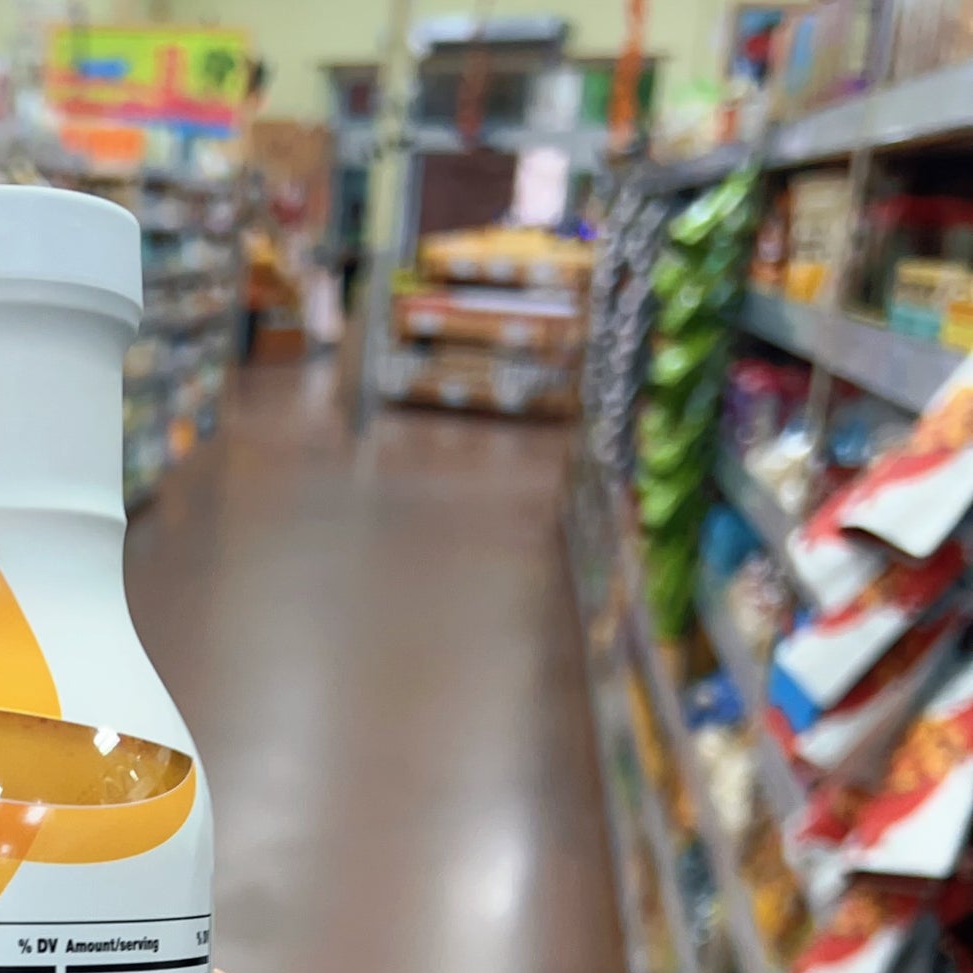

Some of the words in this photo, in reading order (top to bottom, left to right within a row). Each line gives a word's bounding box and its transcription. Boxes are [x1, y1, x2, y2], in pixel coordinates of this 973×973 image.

[18, 938, 32, 954] %
[37, 938, 58, 953] DV
[65, 936, 159, 954] Amount/serving
